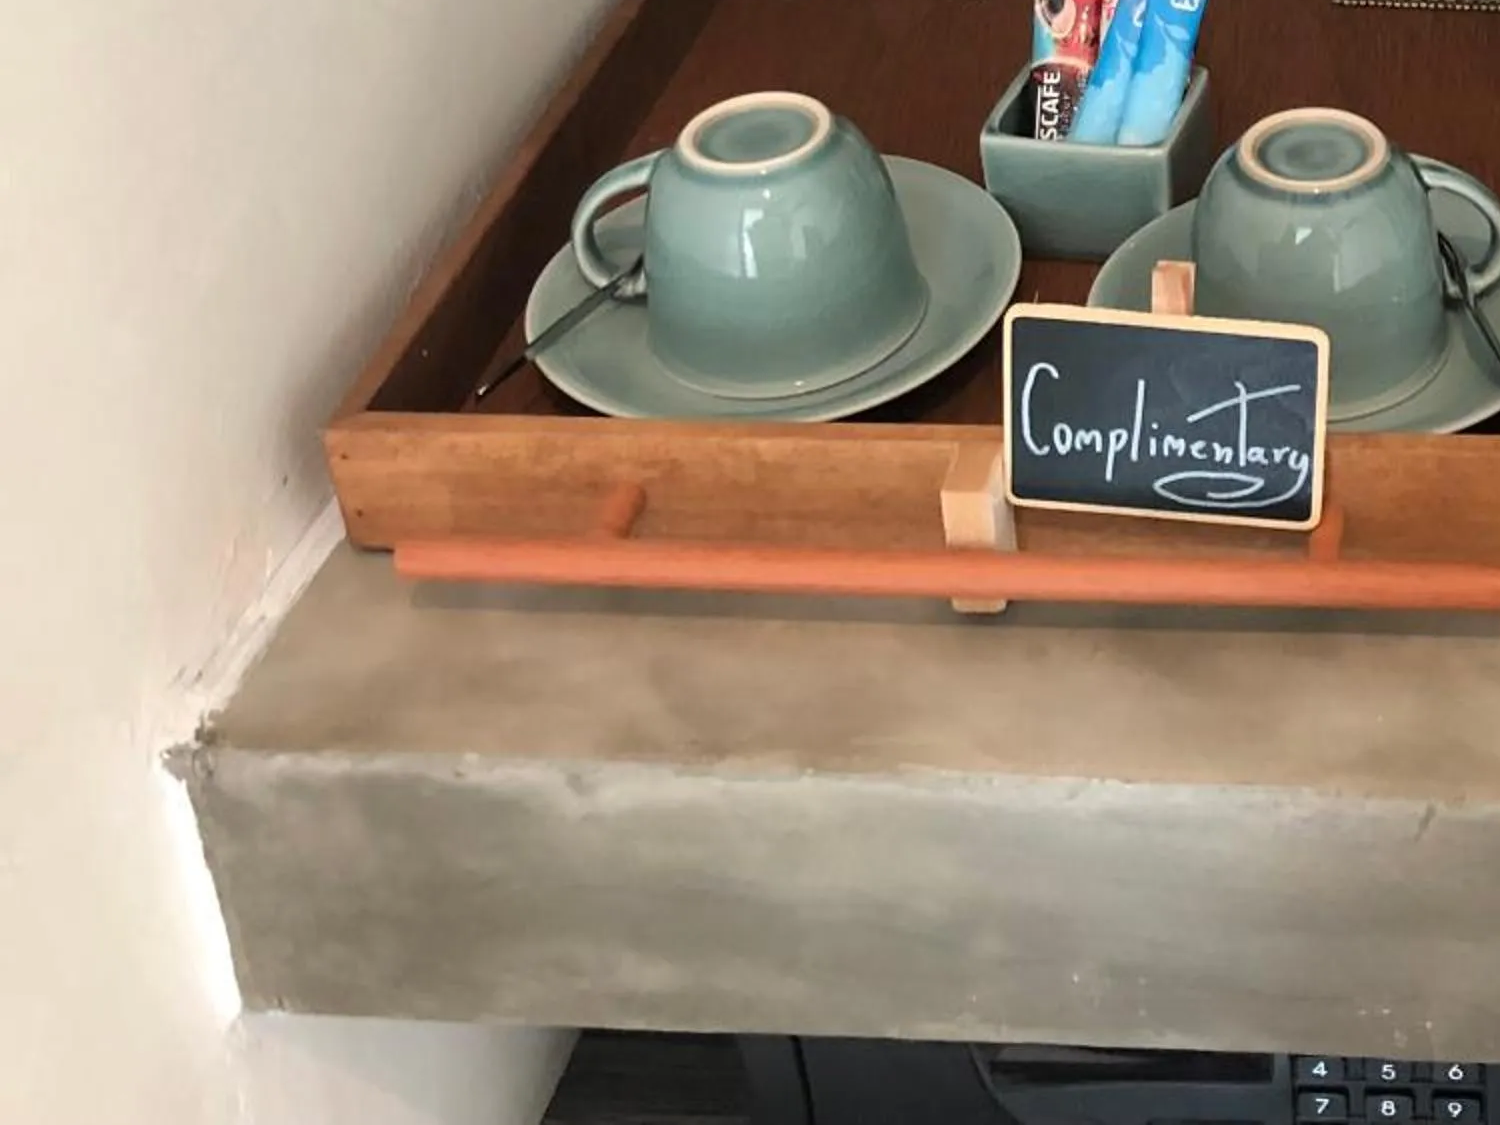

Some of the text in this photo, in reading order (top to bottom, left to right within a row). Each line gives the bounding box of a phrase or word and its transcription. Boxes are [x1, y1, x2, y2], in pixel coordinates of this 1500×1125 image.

[1021, 362, 1310, 508] Complimentary
[1311, 1061, 1464, 1081] 4 5 6
[1314, 1098, 1462, 1118] 7 8 9
